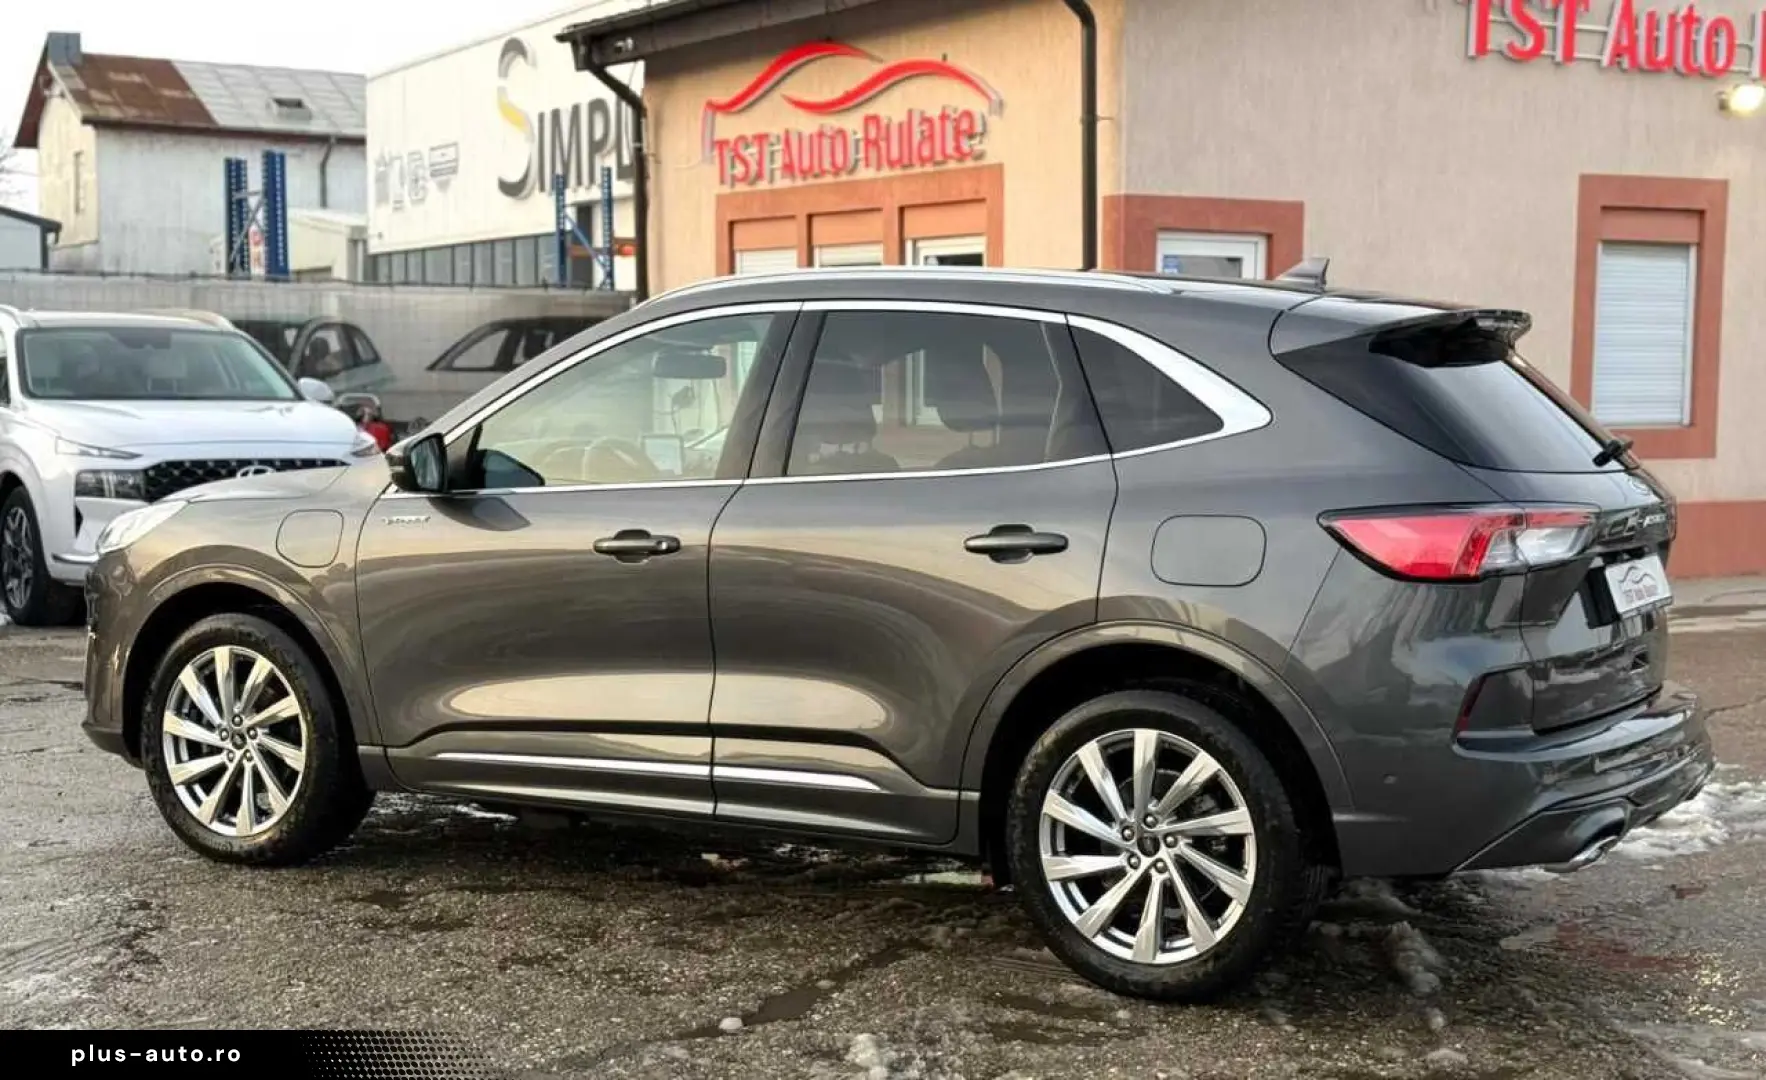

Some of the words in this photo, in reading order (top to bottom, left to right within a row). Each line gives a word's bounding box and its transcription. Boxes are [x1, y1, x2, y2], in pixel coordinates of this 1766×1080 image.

[1607, 0, 1737, 77] Auto
[714, 132, 771, 184] TST
[782, 127, 850, 179] Auto
[863, 108, 977, 172] Rulate
